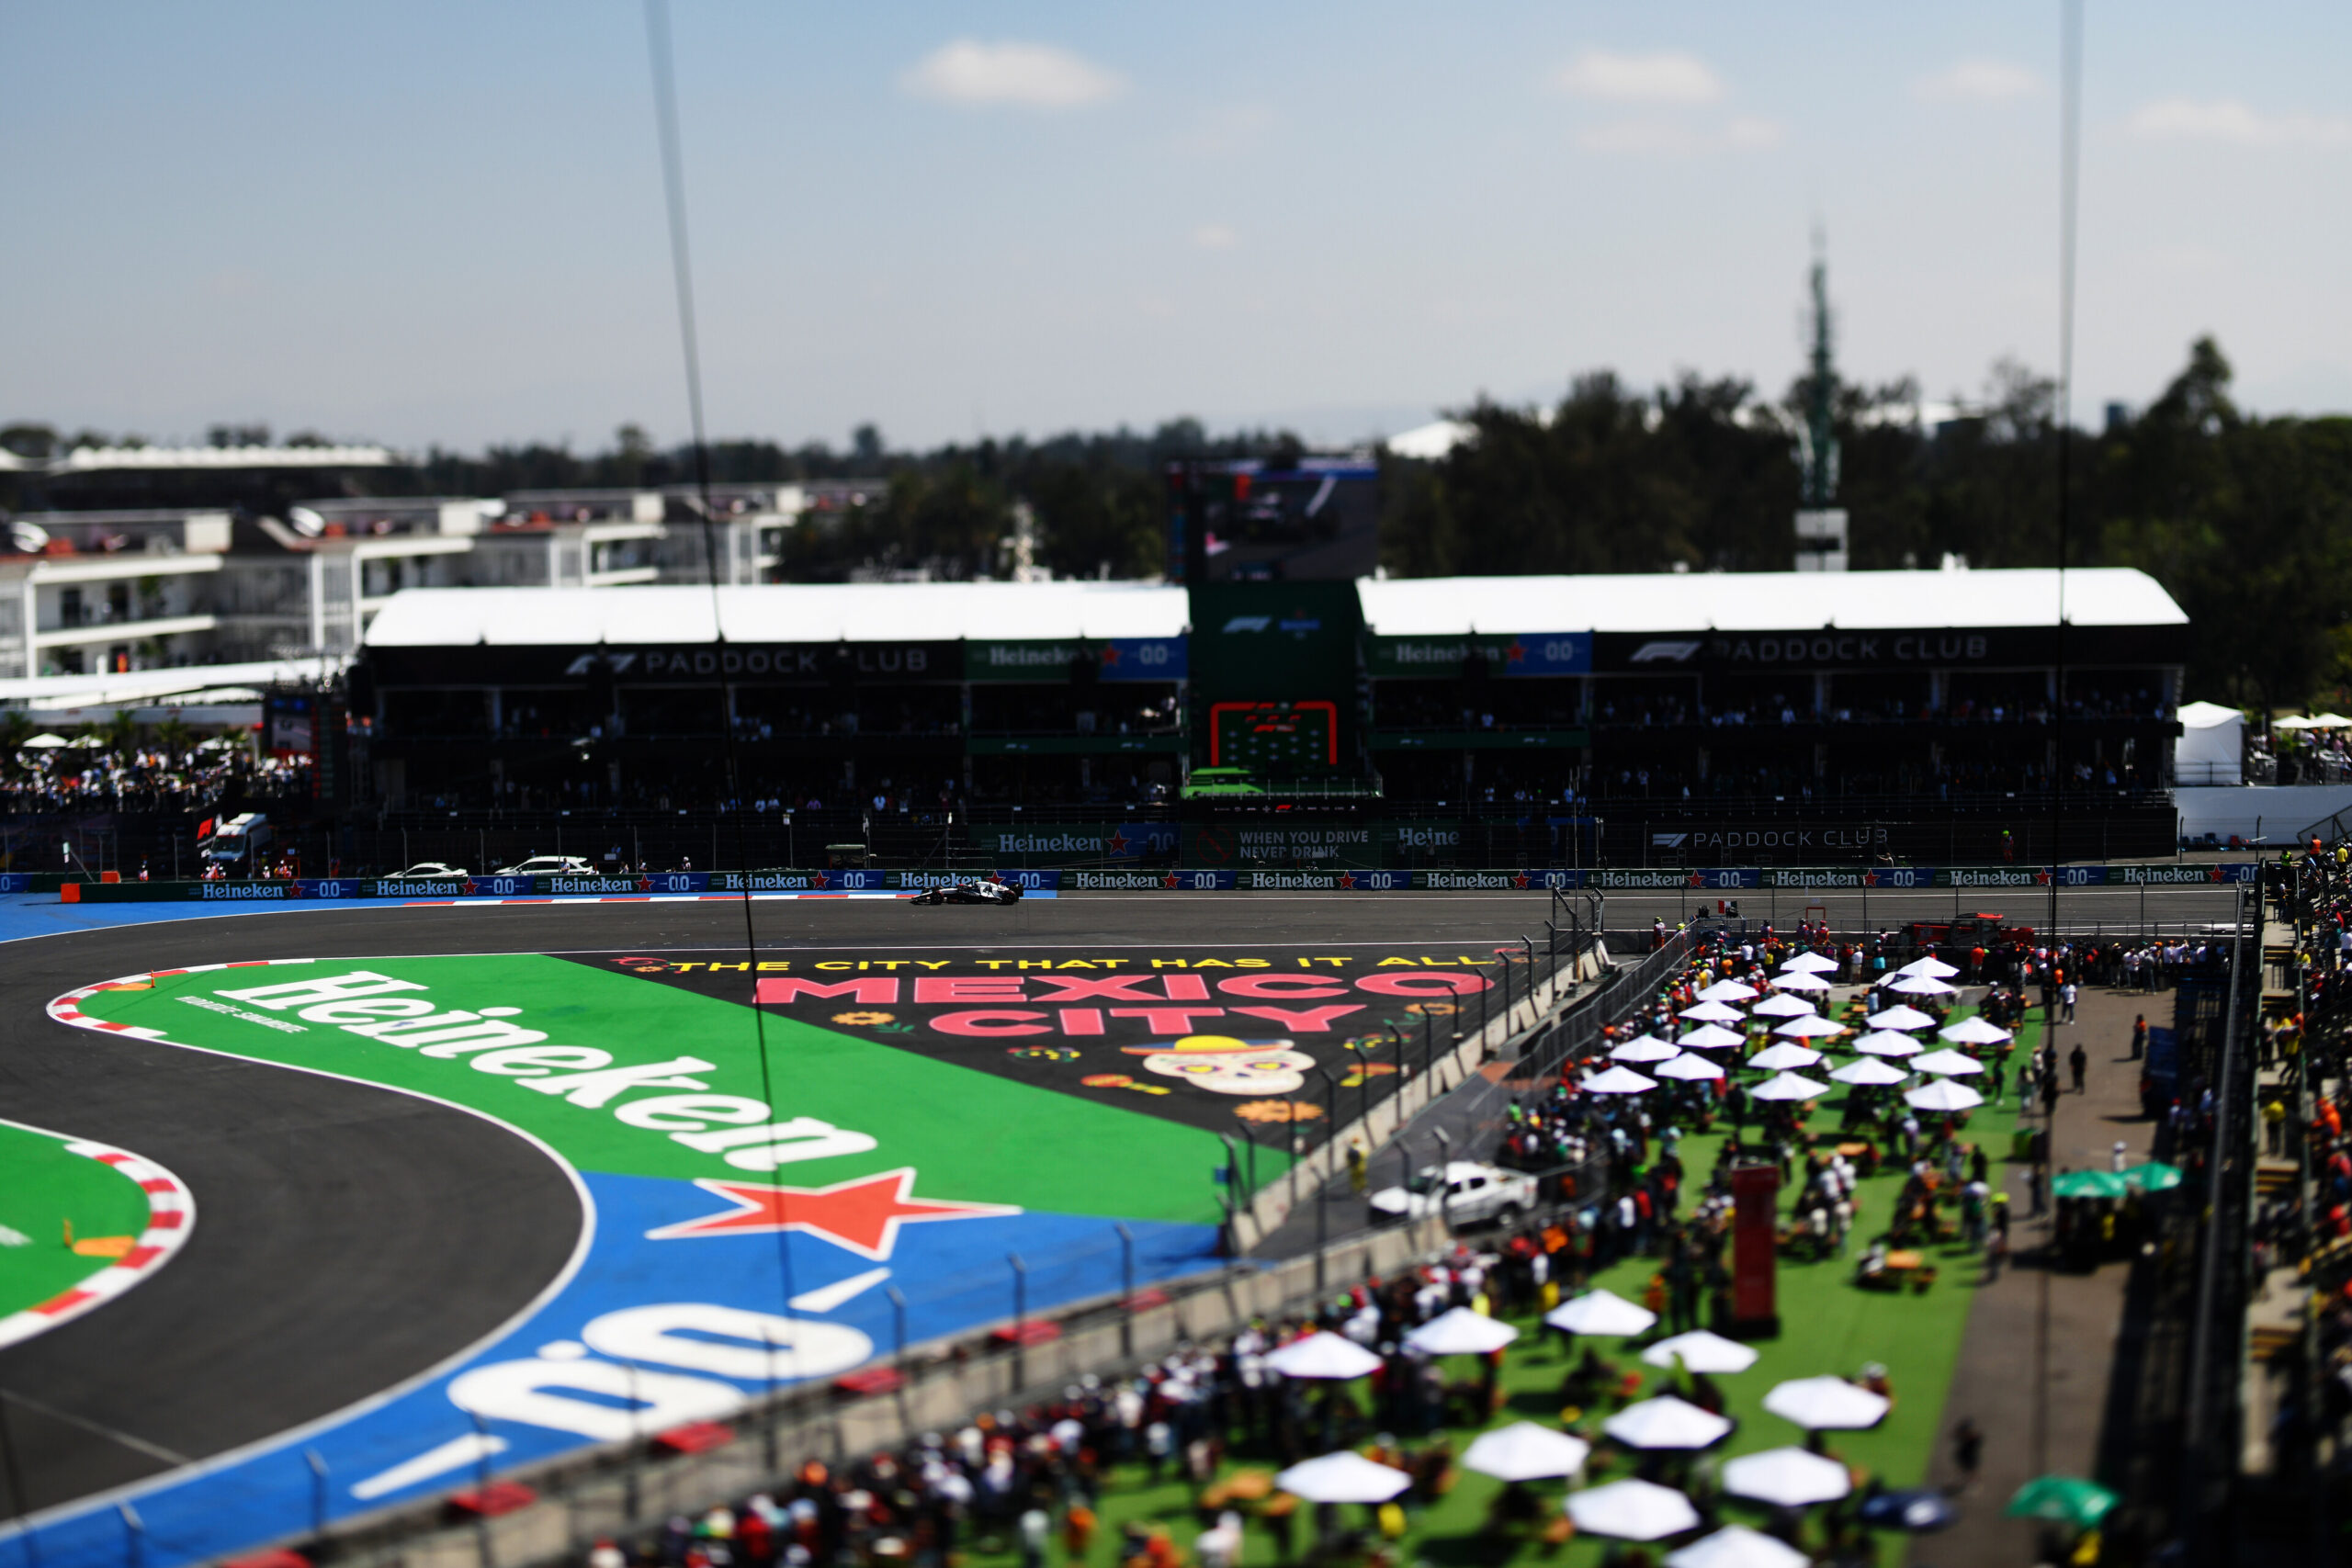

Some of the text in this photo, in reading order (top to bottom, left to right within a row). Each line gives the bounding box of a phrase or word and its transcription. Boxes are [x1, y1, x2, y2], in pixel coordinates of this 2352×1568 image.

[1713, 637, 1880, 661] PADDOCK
[1894, 635, 1987, 660] CLUB
[645, 649, 818, 673] PADDOCK
[856, 648, 928, 672] LUB
[998, 832, 1102, 852] Heineken
[1238, 830, 1369, 844] WHEN YOU DRIVE
[1693, 831, 1813, 847] PADDOCK
[1823, 829, 1889, 846] CLUB
[1239, 845, 1339, 859] NEVER DRINK
[725, 874, 808, 889] Heineken
[899, 872, 982, 887] Heineken
[1076, 872, 1159, 888] Heineken
[1251, 872, 1334, 888] Heineken
[1426, 873, 1510, 888] Heineken
[1601, 872, 1684, 887] Heineken
[1776, 871, 1859, 886] Heineken
[1950, 870, 2032, 886] Heineken
[2123, 867, 2205, 884] Heineken
[202, 884, 284, 899] Heineken
[376, 880, 458, 896] Heineken
[550, 876, 633, 893] Heineken
[669, 955, 1497, 971] THE CITY THAT HAS IT ALL
[752, 971, 1496, 1004] MEXICO
[928, 1004, 1368, 1037] CITY
[211, 971, 878, 1171] Heineken
